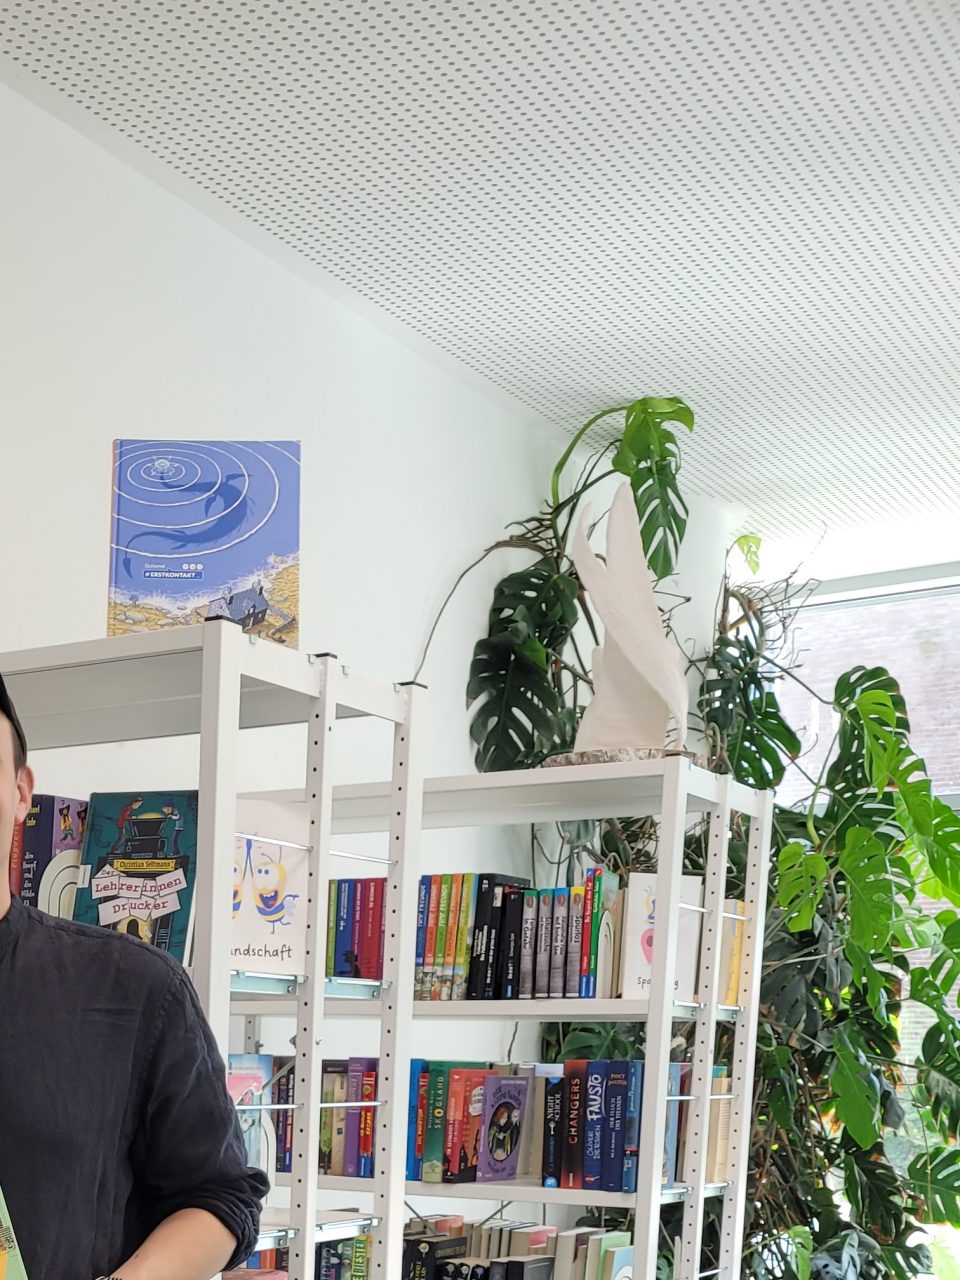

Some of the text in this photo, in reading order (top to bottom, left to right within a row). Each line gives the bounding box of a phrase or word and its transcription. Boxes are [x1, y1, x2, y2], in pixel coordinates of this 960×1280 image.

[95, 876, 182, 893] Lehrerinnen
[112, 899, 169, 914] Drucker
[434, 1076, 443, 1128] SKOGLAND
[569, 1078, 580, 1144] CHANGERS
[587, 1074, 602, 1121] FAUSTO
[352, 1239, 365, 1274] BIESTER
